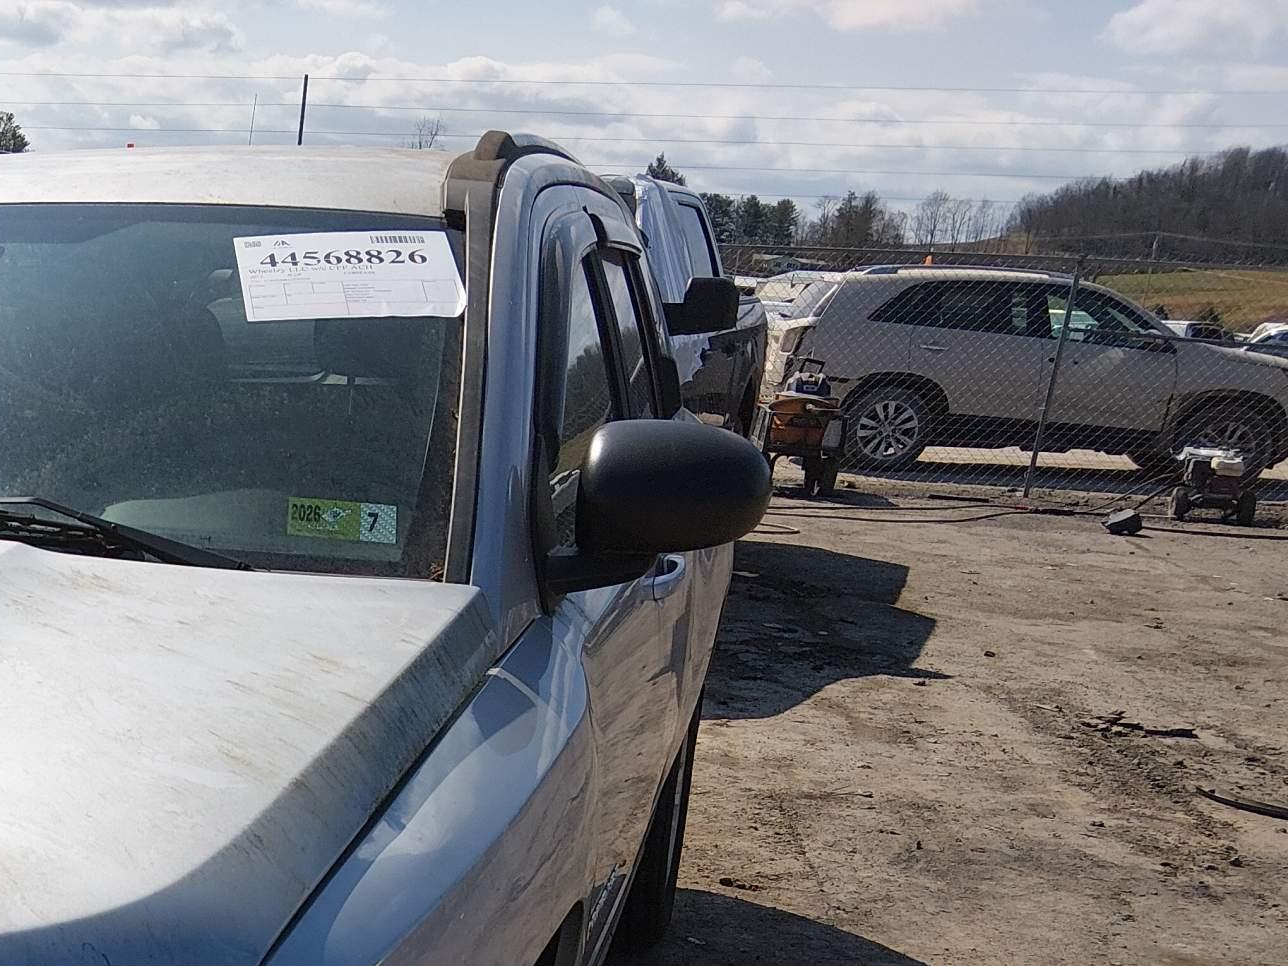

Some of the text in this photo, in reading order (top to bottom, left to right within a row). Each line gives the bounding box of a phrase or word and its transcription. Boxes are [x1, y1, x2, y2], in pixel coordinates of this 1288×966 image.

[260, 248, 427, 268] 44568826
[290, 503, 321, 523] 2026
[367, 511, 379, 532] 7
